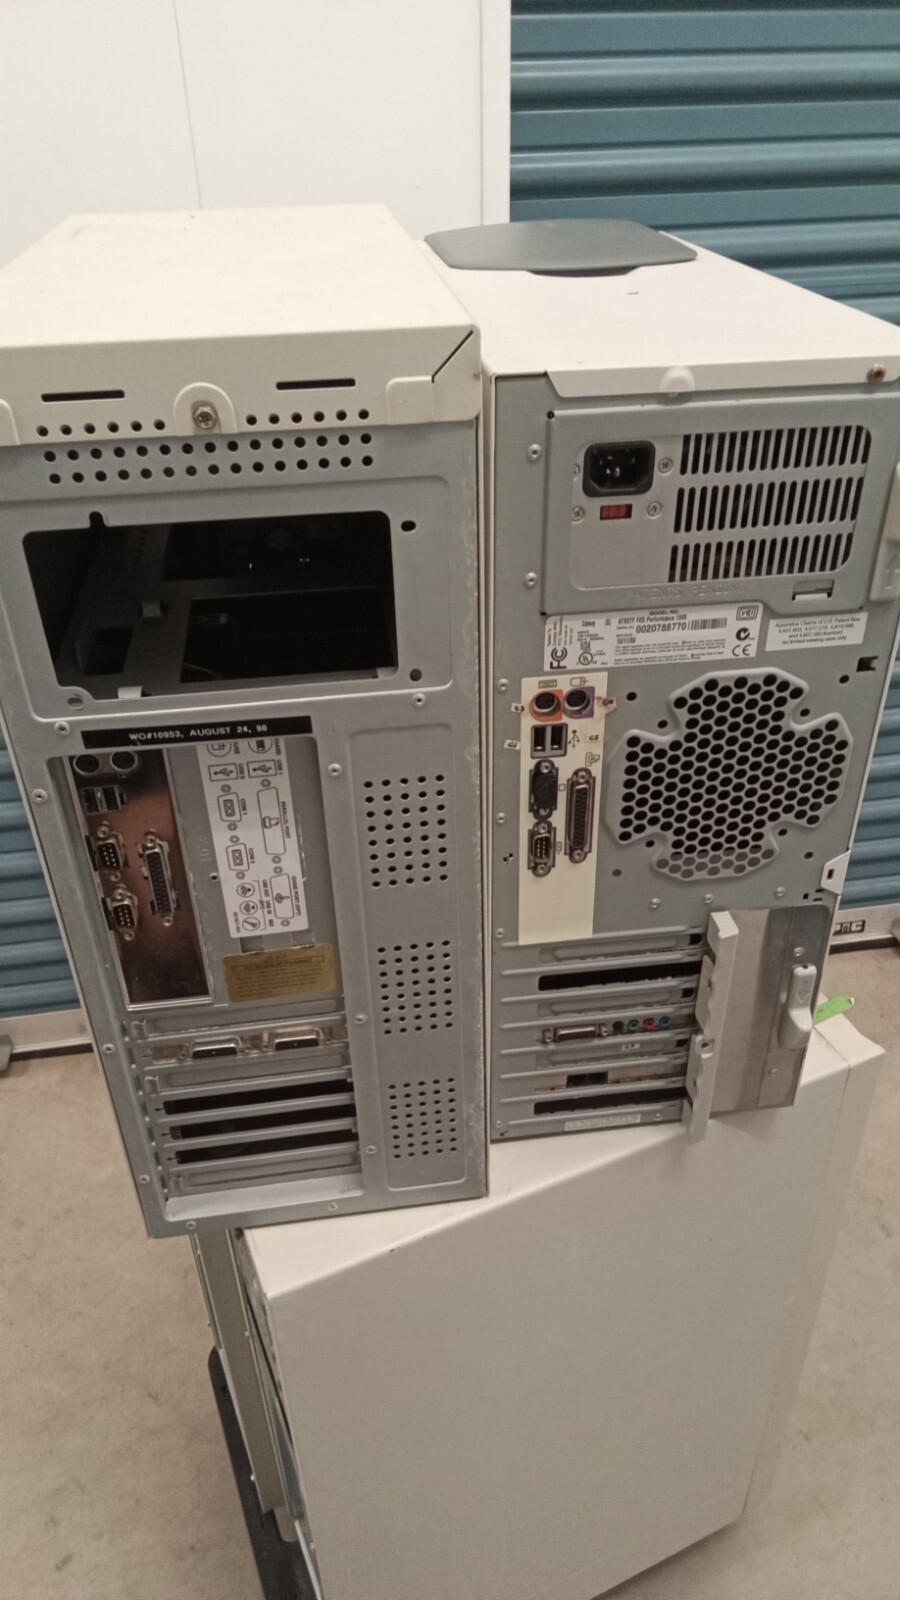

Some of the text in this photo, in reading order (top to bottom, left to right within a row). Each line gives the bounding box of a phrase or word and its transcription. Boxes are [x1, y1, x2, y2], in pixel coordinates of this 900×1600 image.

[636, 622, 687, 633] 0020788770
[128, 724, 268, 741] WO#10953, AUGUST 24, 98
